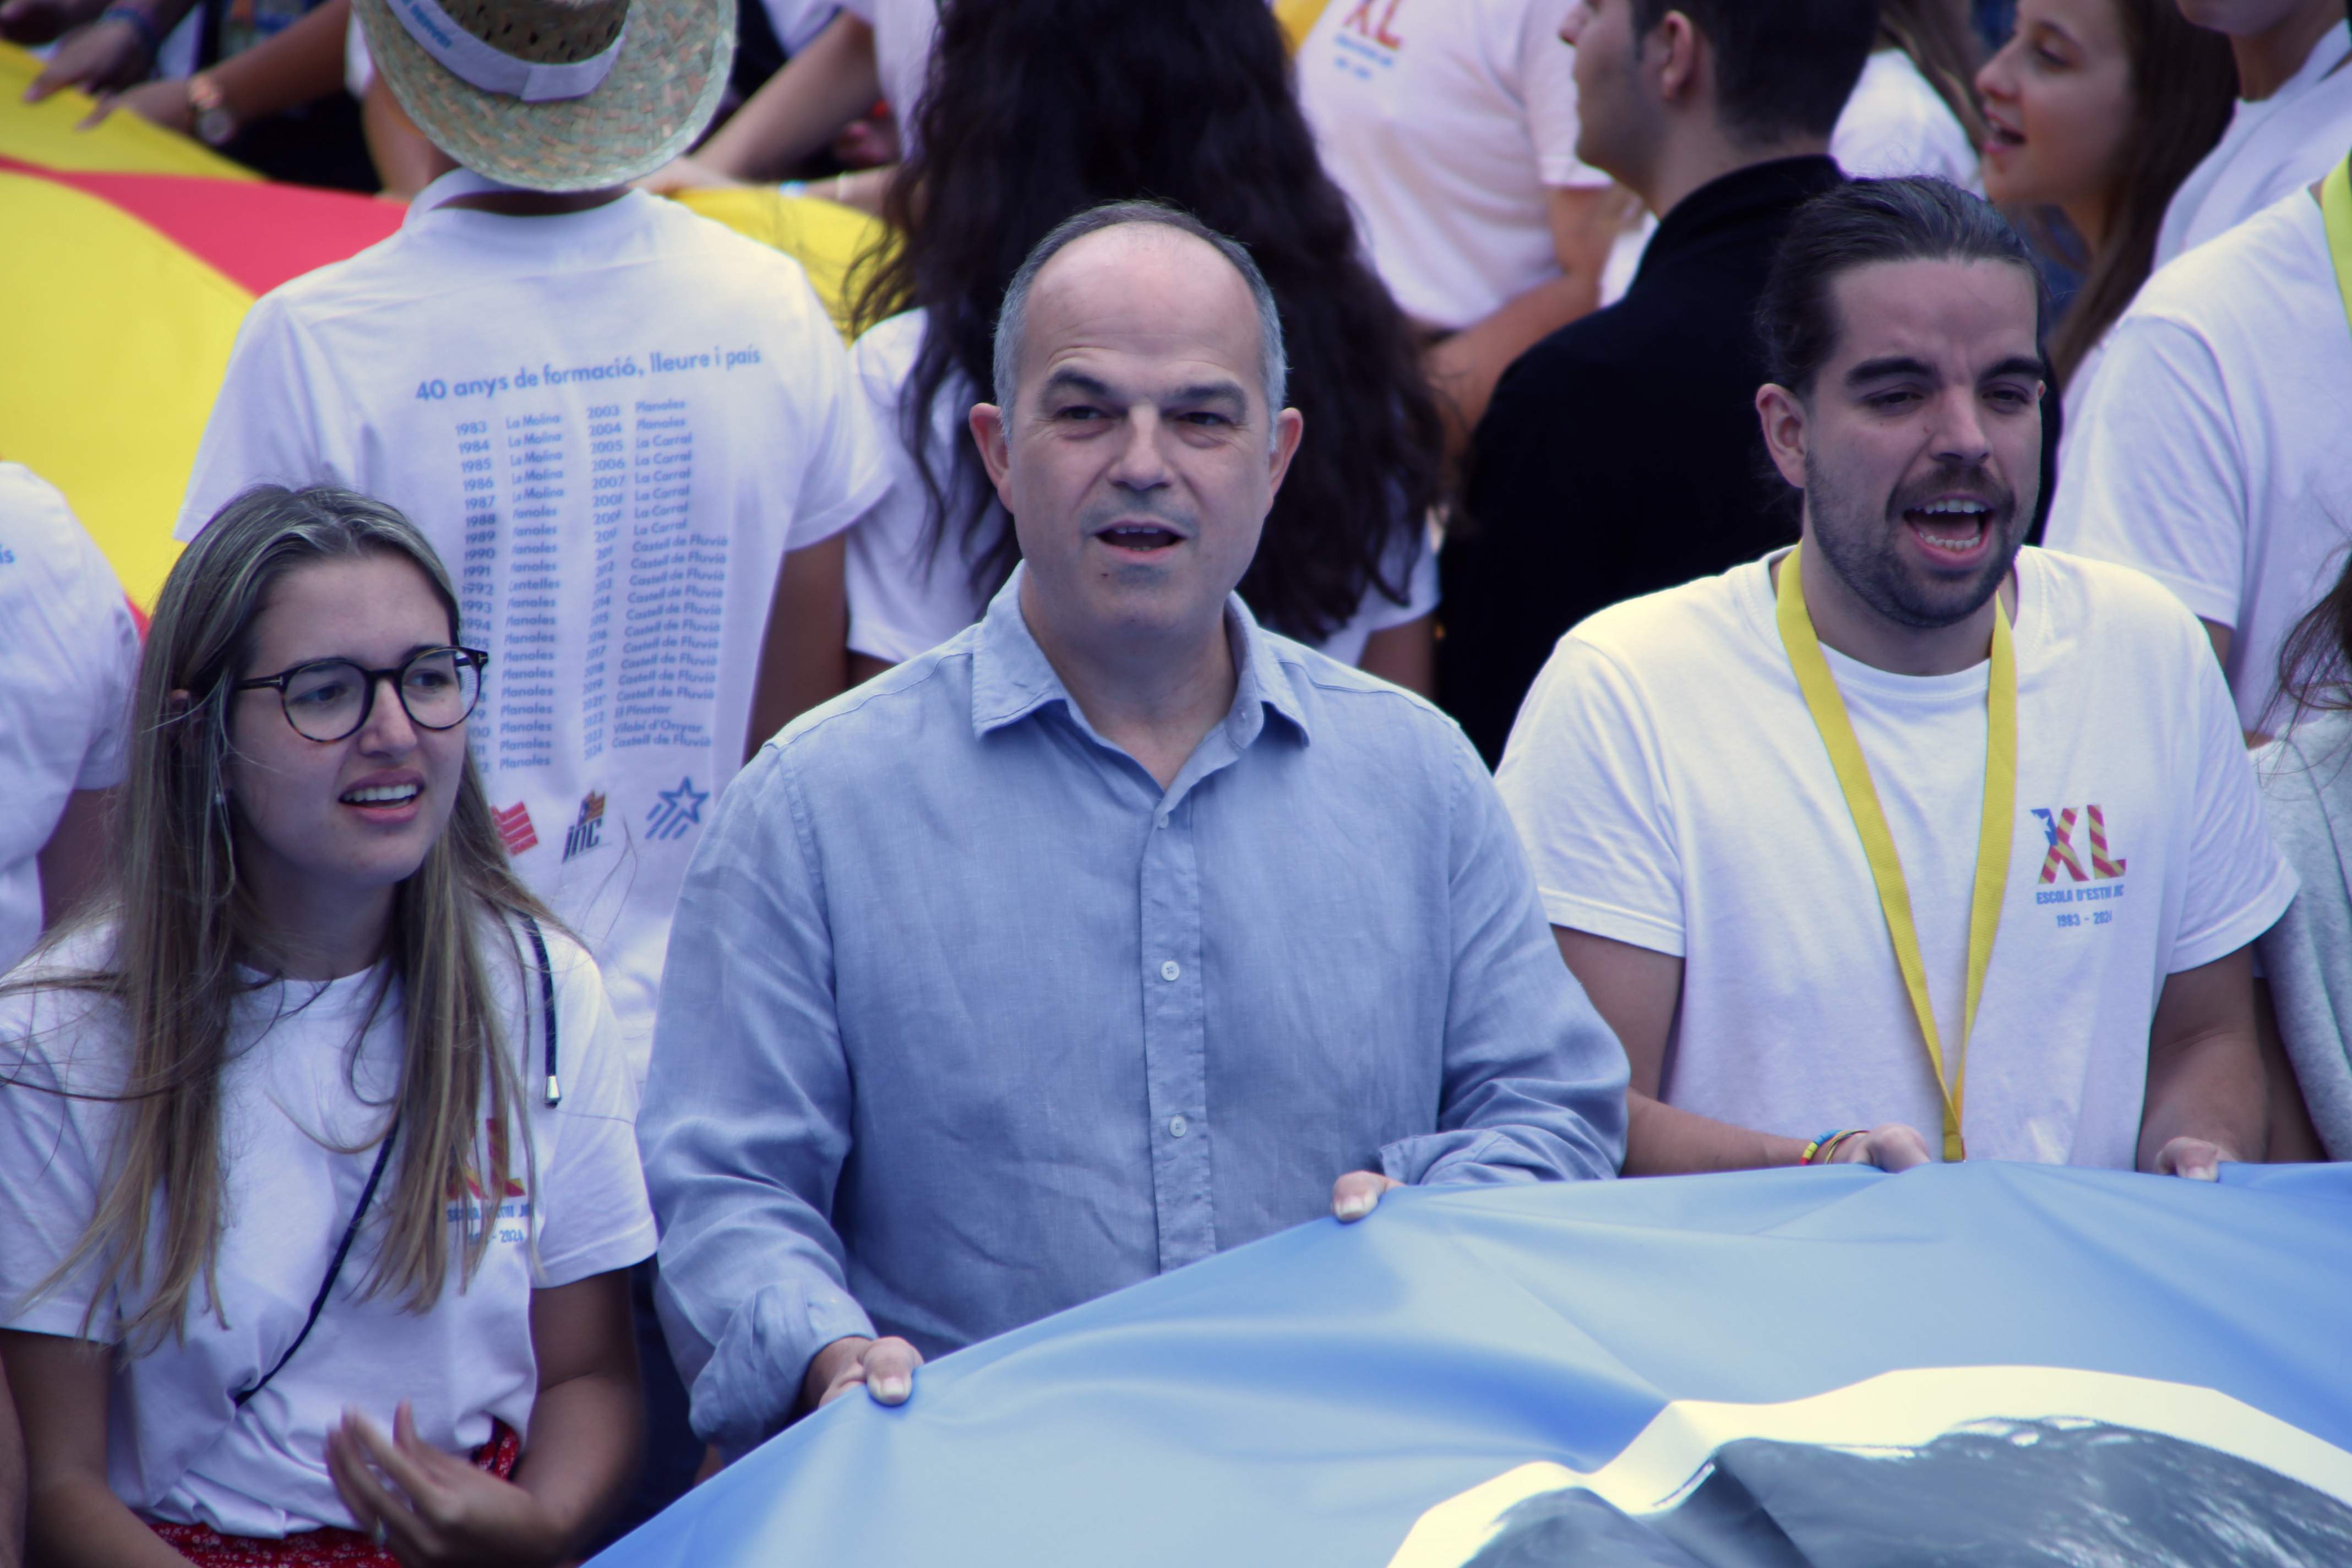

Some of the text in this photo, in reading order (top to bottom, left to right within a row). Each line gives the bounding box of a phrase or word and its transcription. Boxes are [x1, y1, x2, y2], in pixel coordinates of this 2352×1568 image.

[416, 344, 760, 400] 40 anys de formació, lleure i país
[586, 405, 619, 420] 2003
[455, 421, 487, 436] 1983
[522, 413, 560, 427] Molina
[589, 422, 622, 437] 2004
[459, 439, 489, 455] 1984
[524, 432, 562, 445] Molina
[591, 439, 623, 454] 2005
[636, 437, 649, 449] La
[461, 458, 492, 473] 1985
[524, 450, 563, 463] Molina
[592, 458, 625, 473] 2006
[635, 455, 650, 466] La
[464, 476, 494, 492] 1986
[524, 469, 563, 482] Molina
[592, 475, 625, 490] 2007
[635, 472, 650, 484] La
[465, 494, 495, 510] 1987
[524, 487, 564, 499] Molina
[635, 489, 649, 501] La
[466, 513, 496, 528] 1988
[634, 507, 649, 519] La
[465, 530, 496, 545] 1989
[634, 524, 648, 536] La
[633, 536, 671, 553] Castell
[672, 536, 687, 546] de
[465, 547, 496, 562] 1990
[630, 554, 669, 570] Castell
[671, 553, 685, 564] de
[464, 564, 491, 577] 1991
[629, 570, 668, 586] Castell
[669, 570, 683, 581] de
[627, 587, 666, 603] Castell
[668, 587, 682, 598] de
[462, 600, 492, 614] 1993
[626, 604, 664, 620] Castell
[666, 602, 680, 614] de
[624, 620, 662, 638] Castell
[664, 619, 679, 631] de
[623, 636, 660, 654] Castell
[662, 635, 678, 648] de
[503, 649, 554, 665] Planoles
[621, 653, 658, 670] Castell
[661, 652, 676, 665] de
[502, 667, 554, 682] Planoles
[618, 670, 656, 686] Castell
[659, 669, 675, 681] de
[501, 684, 554, 700] Planoles
[616, 687, 654, 702] Castell
[657, 686, 673, 698] de
[500, 702, 554, 717] Planoles
[500, 720, 553, 734] Planoles
[499, 737, 552, 752] Planoles
[612, 734, 651, 749] Castell
[653, 733, 670, 744] de
[499, 754, 551, 770] Planoles
[2030, 804, 2127, 884] XL
[2036, 889, 2073, 905] ESCOLA
[2056, 913, 2081, 928] 1983
[499, 1230, 524, 1243] 2024
